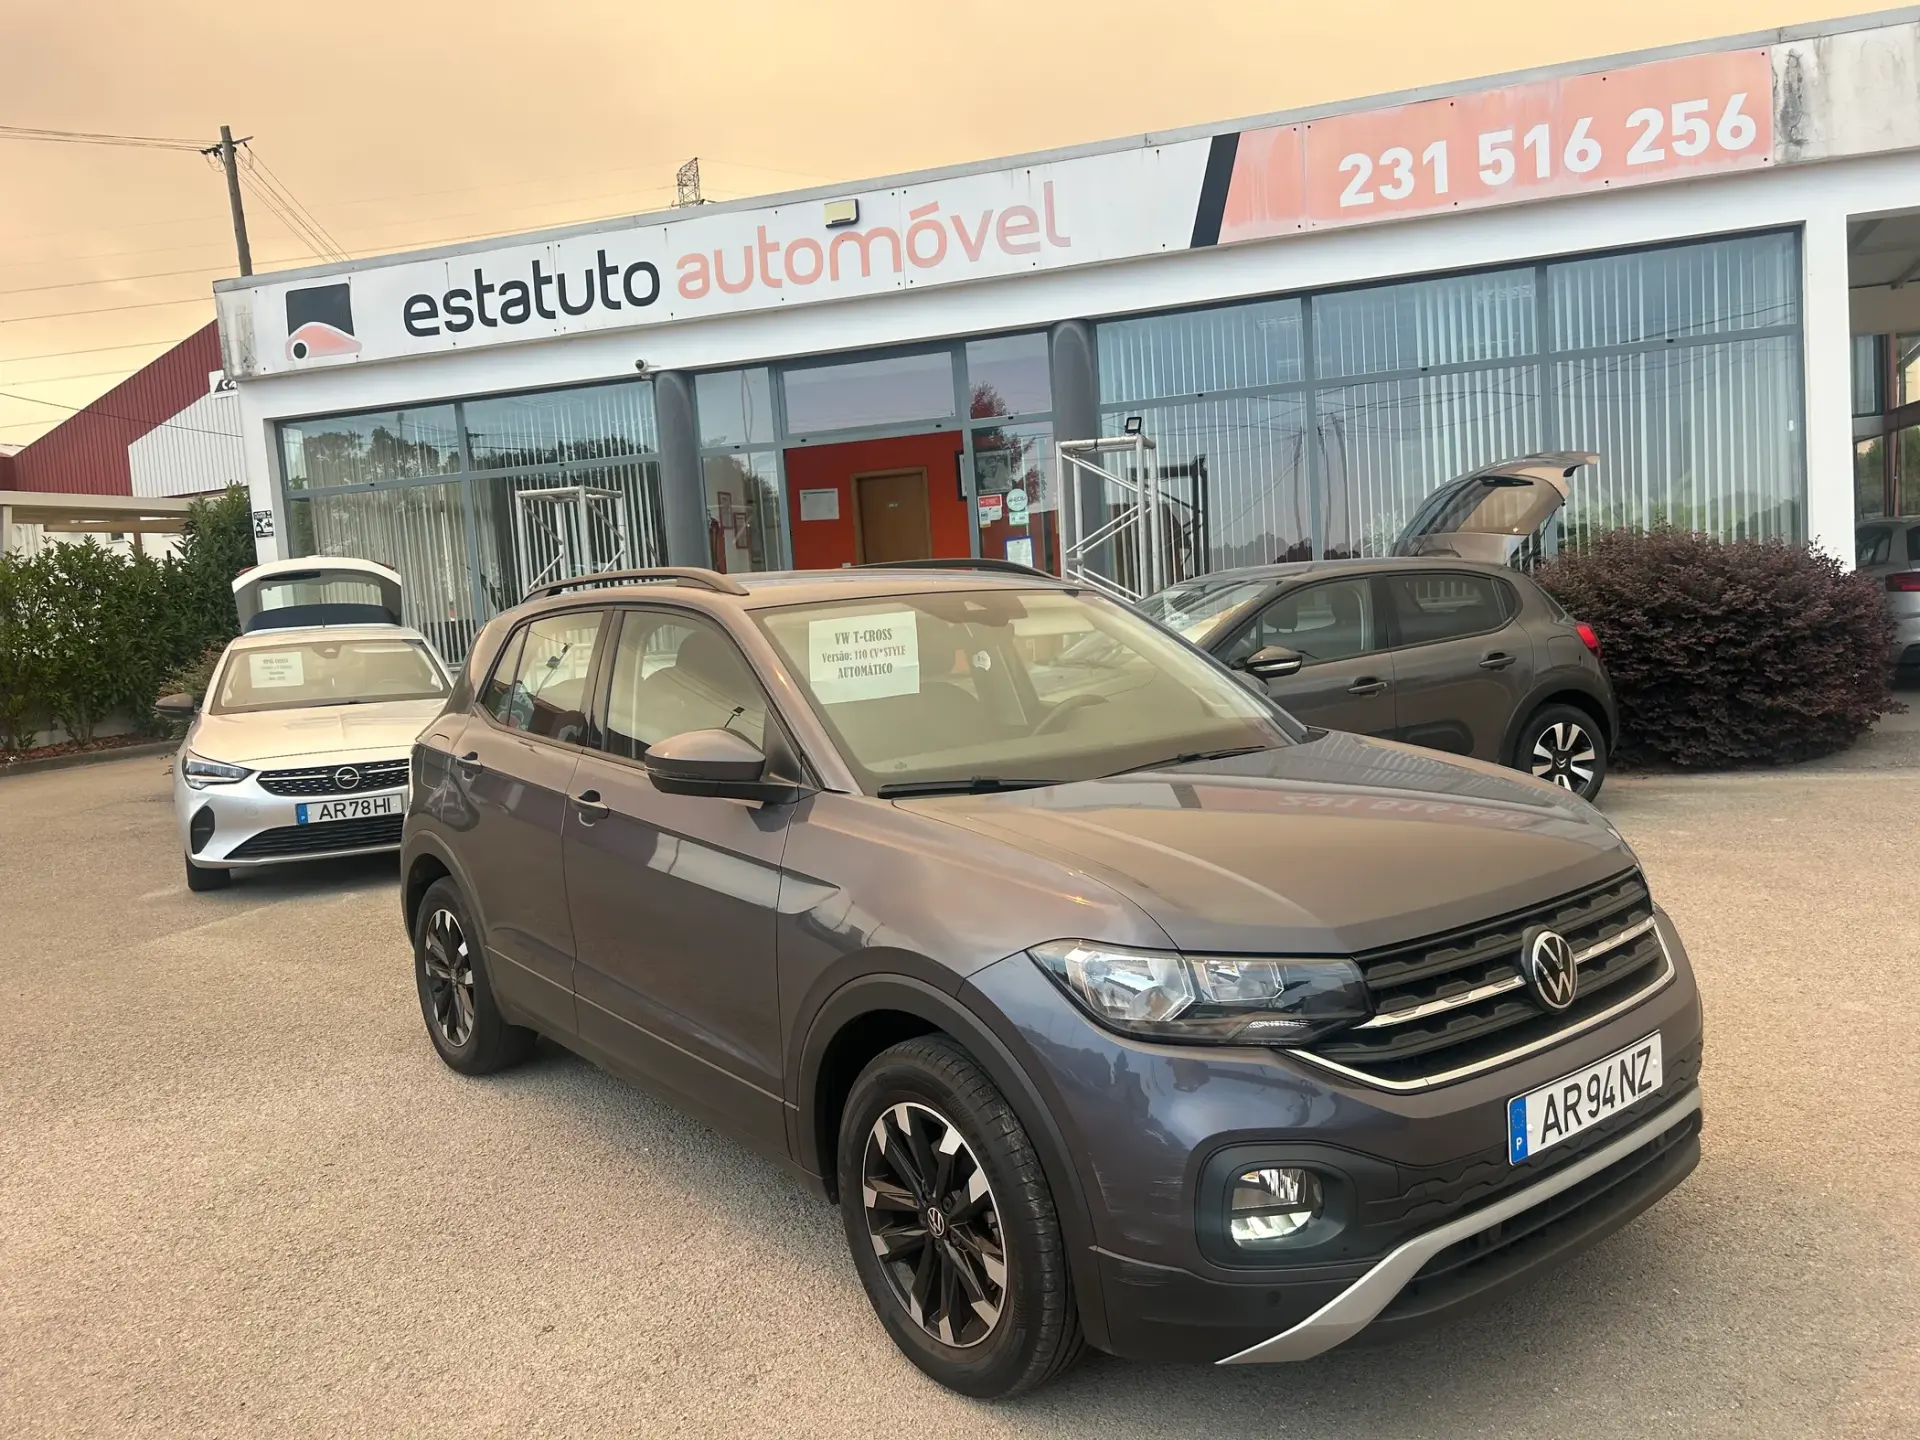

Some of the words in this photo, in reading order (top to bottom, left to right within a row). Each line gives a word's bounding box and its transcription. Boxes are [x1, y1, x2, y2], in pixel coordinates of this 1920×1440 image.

[1338, 140, 1448, 207] 231
[1478, 116, 1602, 186] 516
[1624, 92, 1757, 165] 256
[403, 249, 661, 337] estatuto
[676, 180, 1071, 300] automóvel
[835, 632, 850, 645] VW
[853, 628, 892, 643] T-CROSS
[822, 651, 852, 662] Versão:
[854, 649, 868, 660] 110
[838, 663, 893, 678] AUTOMÁTICO
[1516, 1136, 1522, 1151] P
